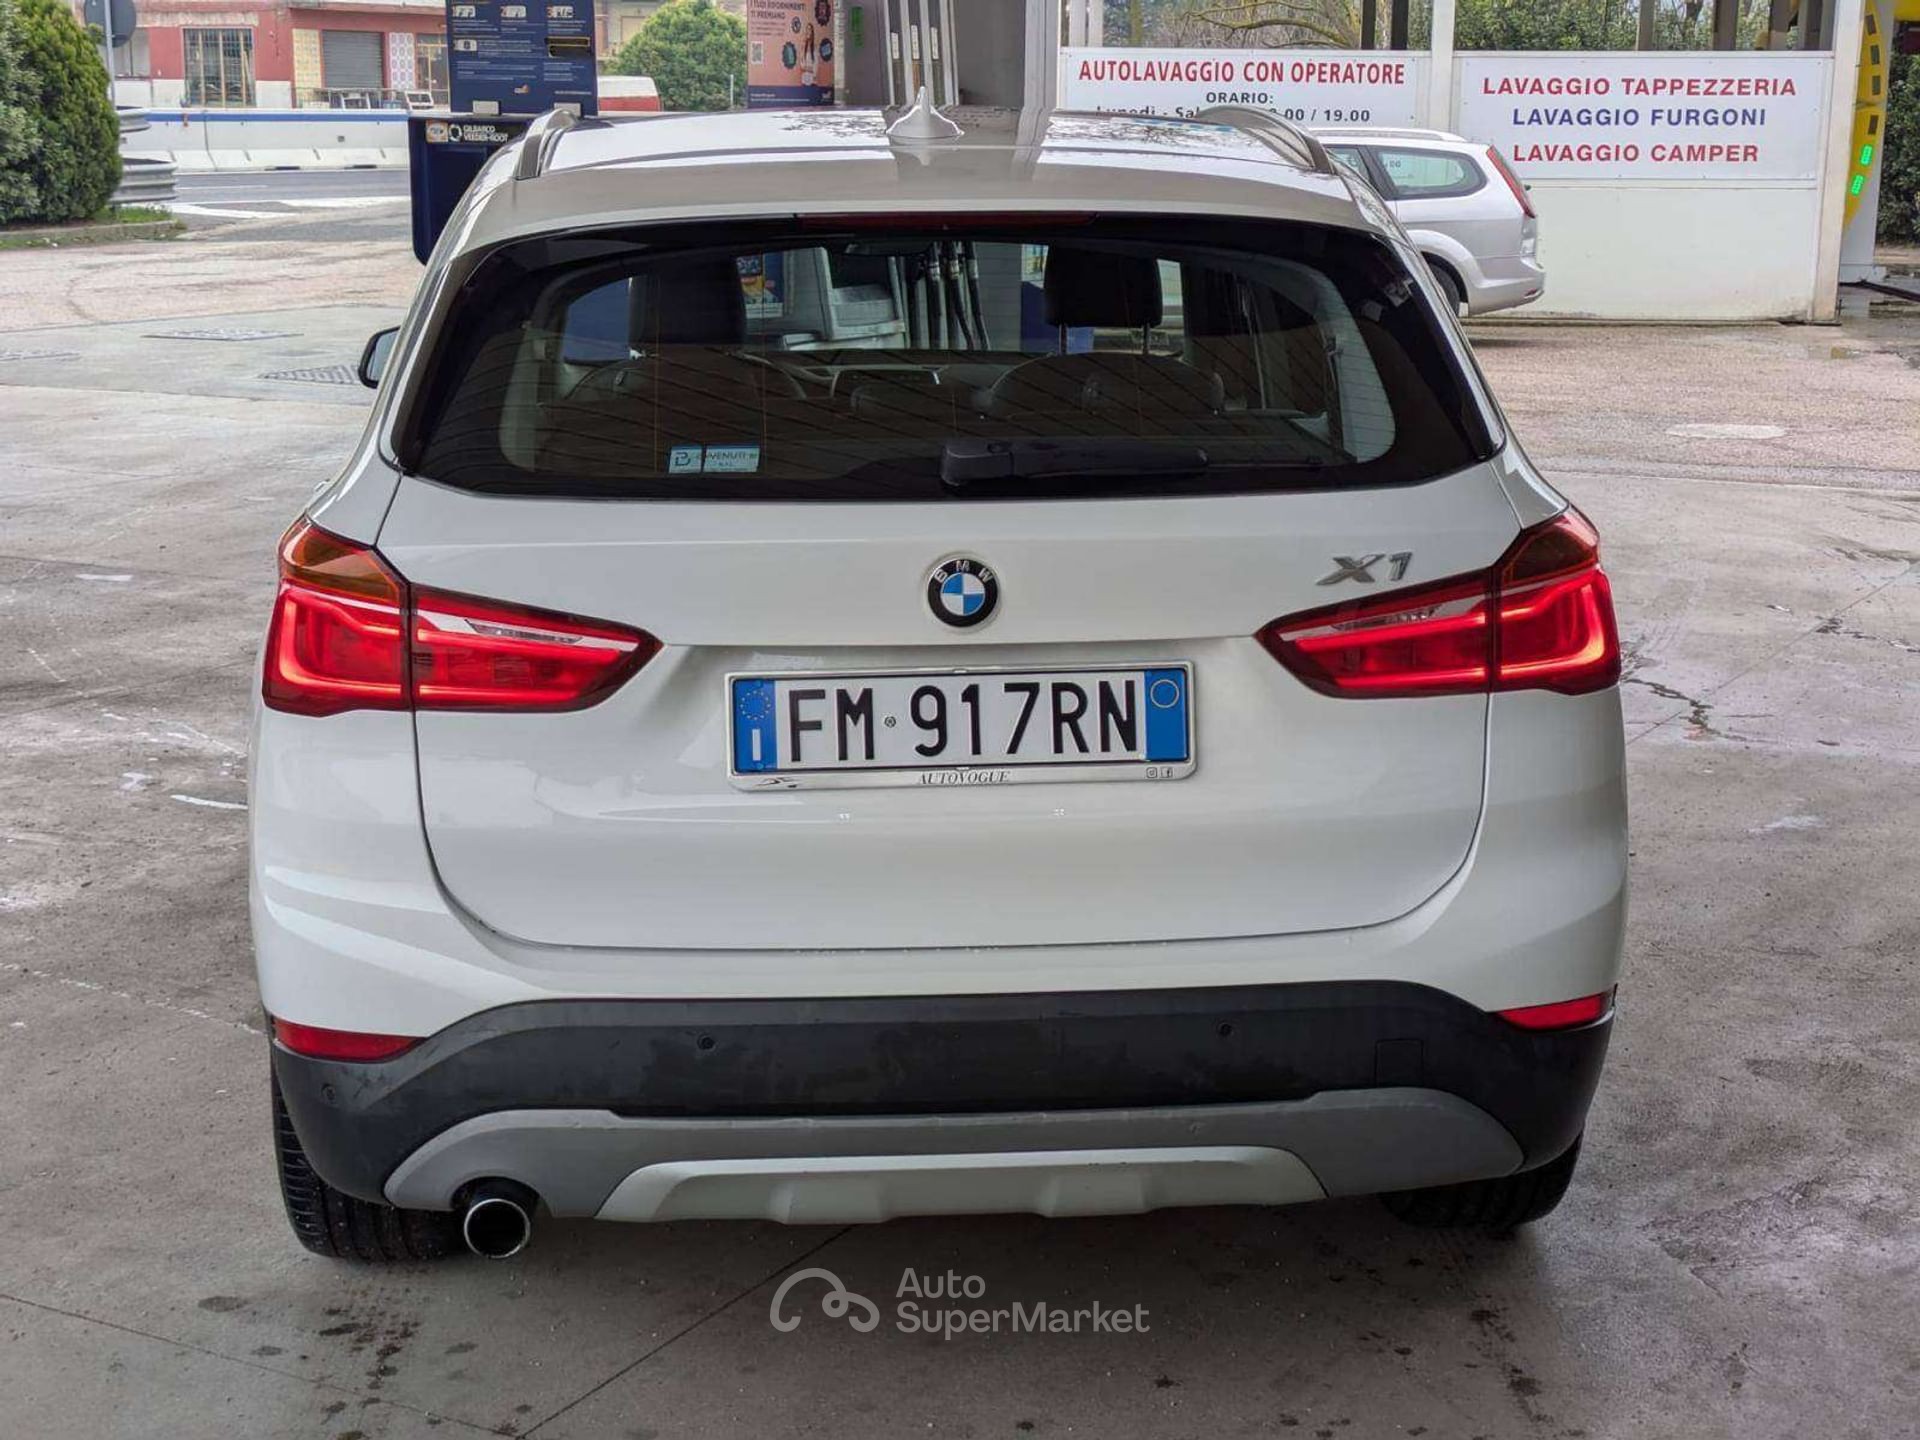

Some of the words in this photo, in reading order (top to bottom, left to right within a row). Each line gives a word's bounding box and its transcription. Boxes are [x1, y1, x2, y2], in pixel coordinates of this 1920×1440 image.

[1079, 60, 1234, 83] AUTOLAVAGGIO
[1243, 61, 1284, 83] CON
[1290, 62, 1405, 84] OPERATORE
[1483, 77, 1610, 95] LAVAGGIO
[1621, 78, 1796, 96] TAPPEZZERIA
[1206, 91, 1274, 104] ORARIO:
[1324, 109, 1370, 122] 19.00
[1513, 109, 1639, 126] LAVAGGIO
[1650, 108, 1766, 126] FURGONI
[1513, 144, 1639, 162] LAVAGGIO
[1650, 144, 1758, 162] CAMPER
[934, 560, 994, 584] BMW
[1315, 551, 1414, 586] X1
[788, 687, 876, 762] FM
[910, 679, 1138, 758] 917RN
[918, 769, 1010, 786] AUTOVOGUE
